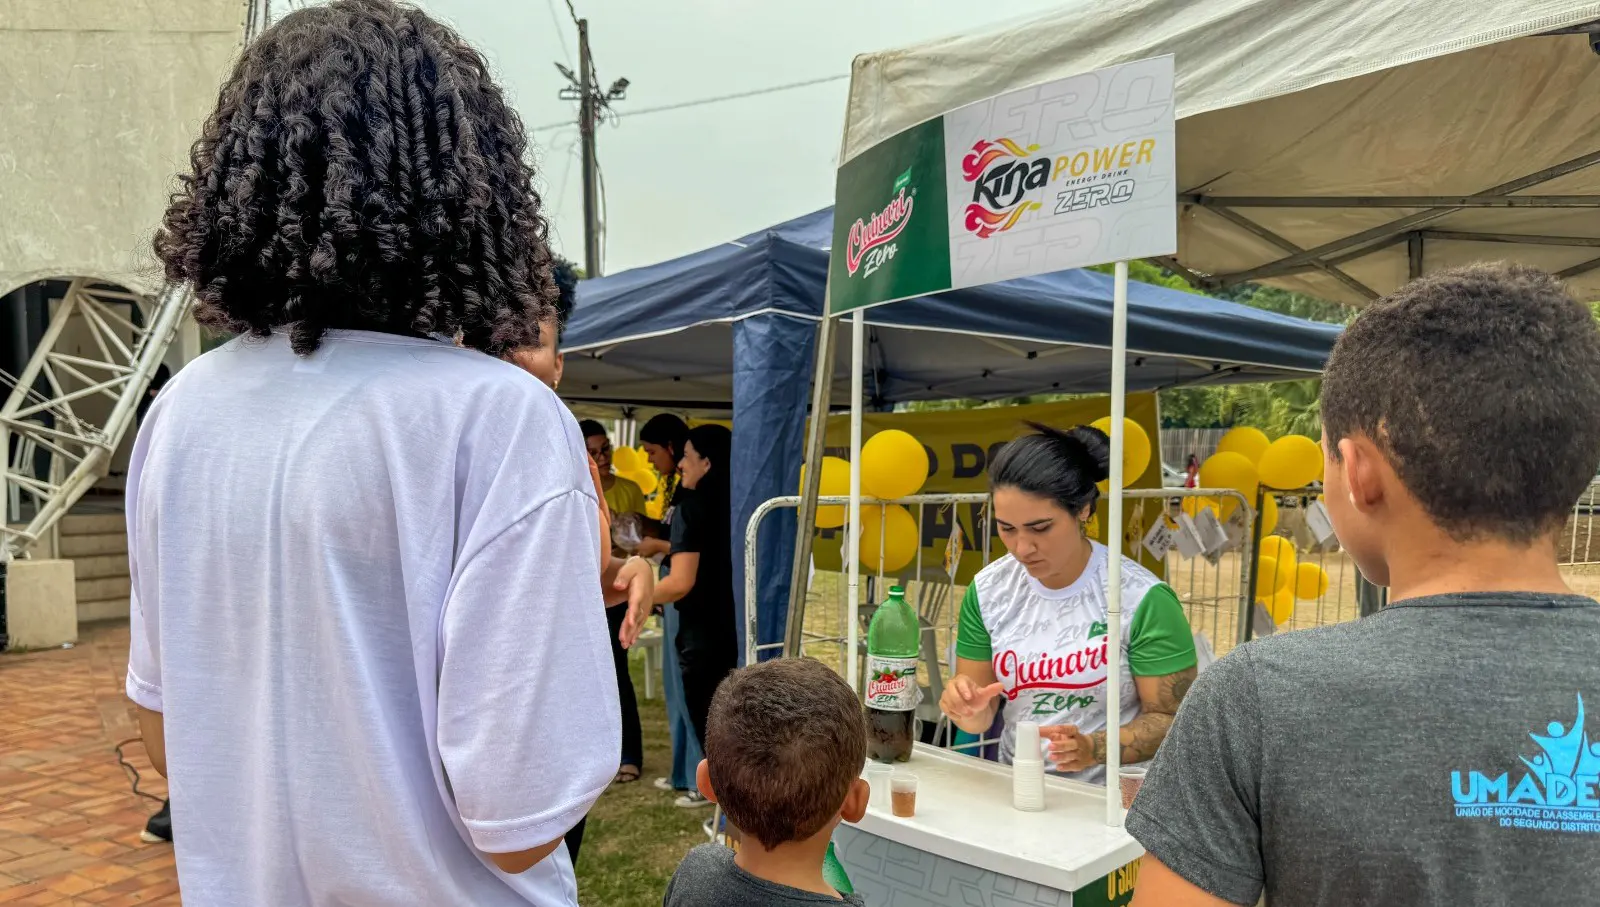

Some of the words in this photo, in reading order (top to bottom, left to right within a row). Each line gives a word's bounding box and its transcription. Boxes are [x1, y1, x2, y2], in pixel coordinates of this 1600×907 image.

[1052, 138, 1156, 182] POWER
[1065, 175, 1098, 187] ENERGY
[1101, 169, 1129, 181] DRINK
[1054, 178, 1136, 216] ZERO
[846, 187, 914, 278] Quinari
[863, 243, 899, 279] Zero
[993, 635, 1108, 700] Quinari
[1032, 692, 1098, 714] Zero
[1451, 771, 1600, 807] UMADE
[1456, 807, 1481, 817] UNIÃO
[1482, 807, 1494, 817] DE
[1495, 807, 1541, 818] MOCIDADE
[1542, 809, 1555, 818] DA
[1499, 818, 1512, 827] DO
[1513, 819, 1560, 830] SEGUNDO
[1561, 822, 1600, 832] DISTRITO
